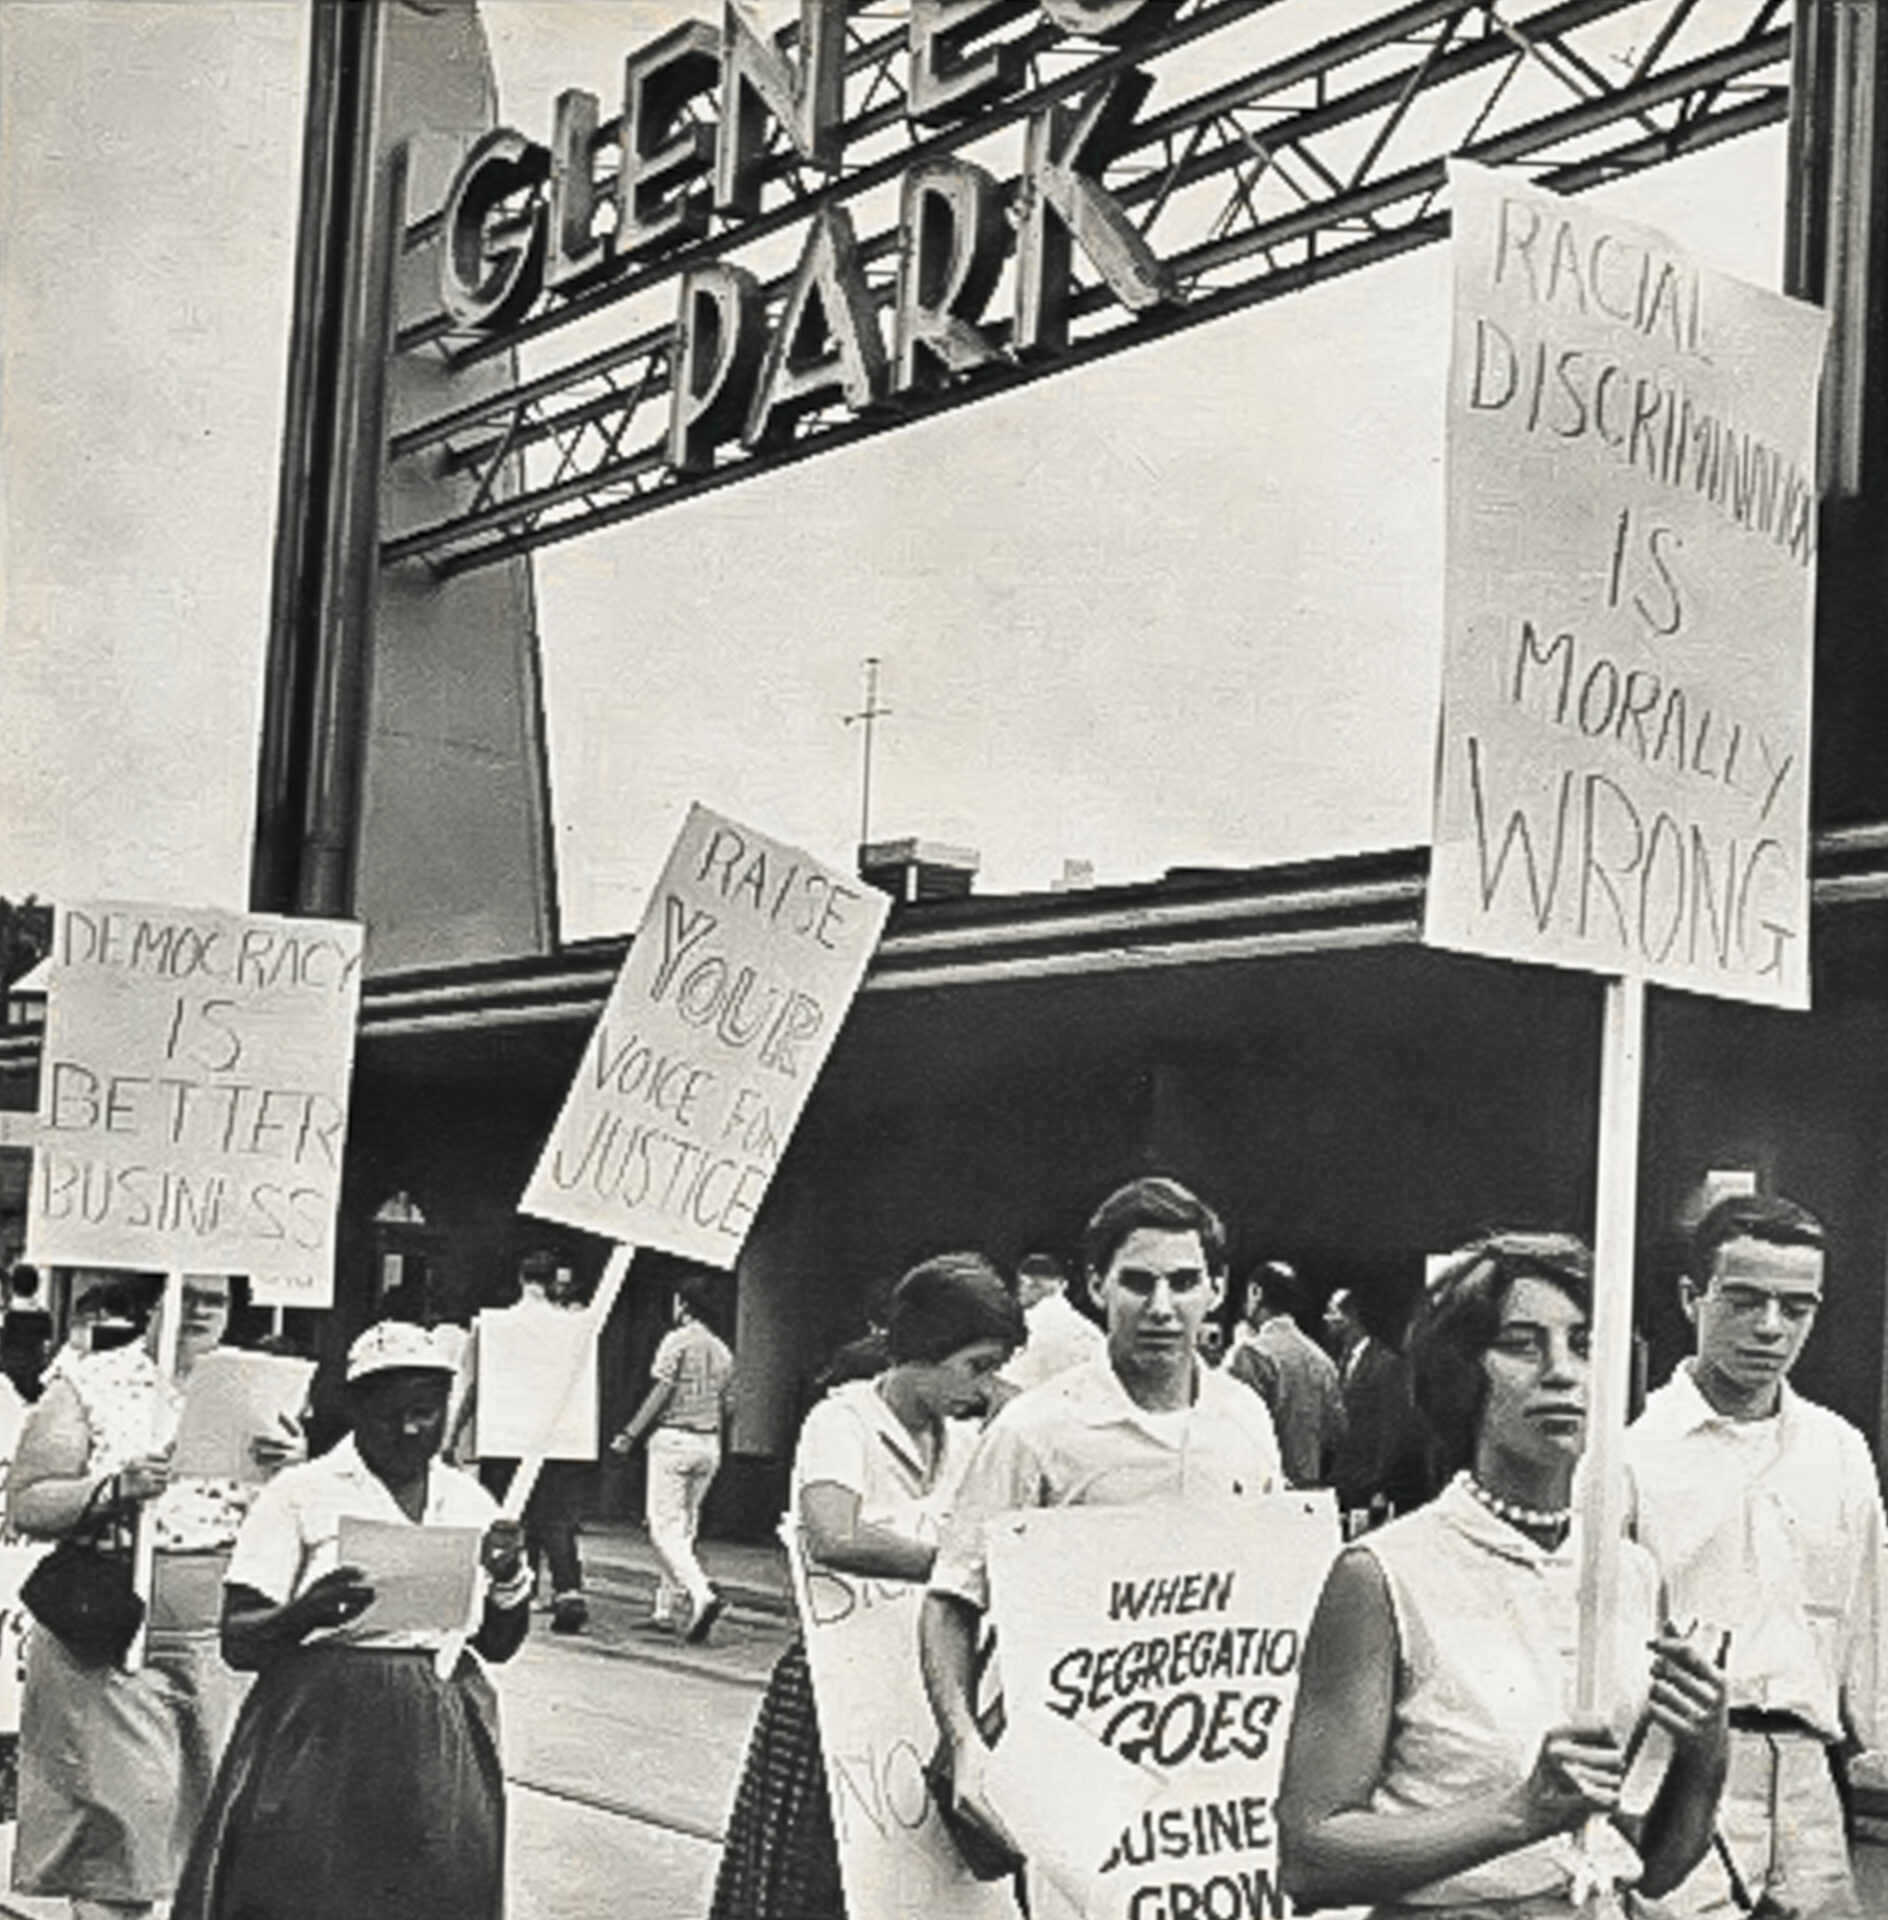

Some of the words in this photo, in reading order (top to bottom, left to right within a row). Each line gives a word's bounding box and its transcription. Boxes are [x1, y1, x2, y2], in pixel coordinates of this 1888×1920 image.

[664, 66, 1170, 474] PARK
[1496, 197, 1714, 366] RACIAL
[1609, 507, 1683, 636] IS
[1513, 620, 1794, 820] MORALLY
[697, 828, 862, 950] RAISE
[1468, 736, 1796, 981] WRONG
[64, 910, 362, 993] DEMOCRACY
[650, 895, 824, 1078] YOUR
[167, 999, 241, 1073] IS
[595, 1026, 713, 1127] VOICE
[42, 1062, 343, 1171] BETTER
[552, 1111, 769, 1237] JUSTICE
[1106, 1571, 1234, 1621] WHEN
[832, 1738, 929, 1839] NO
[1098, 1796, 1272, 1874] USINE
